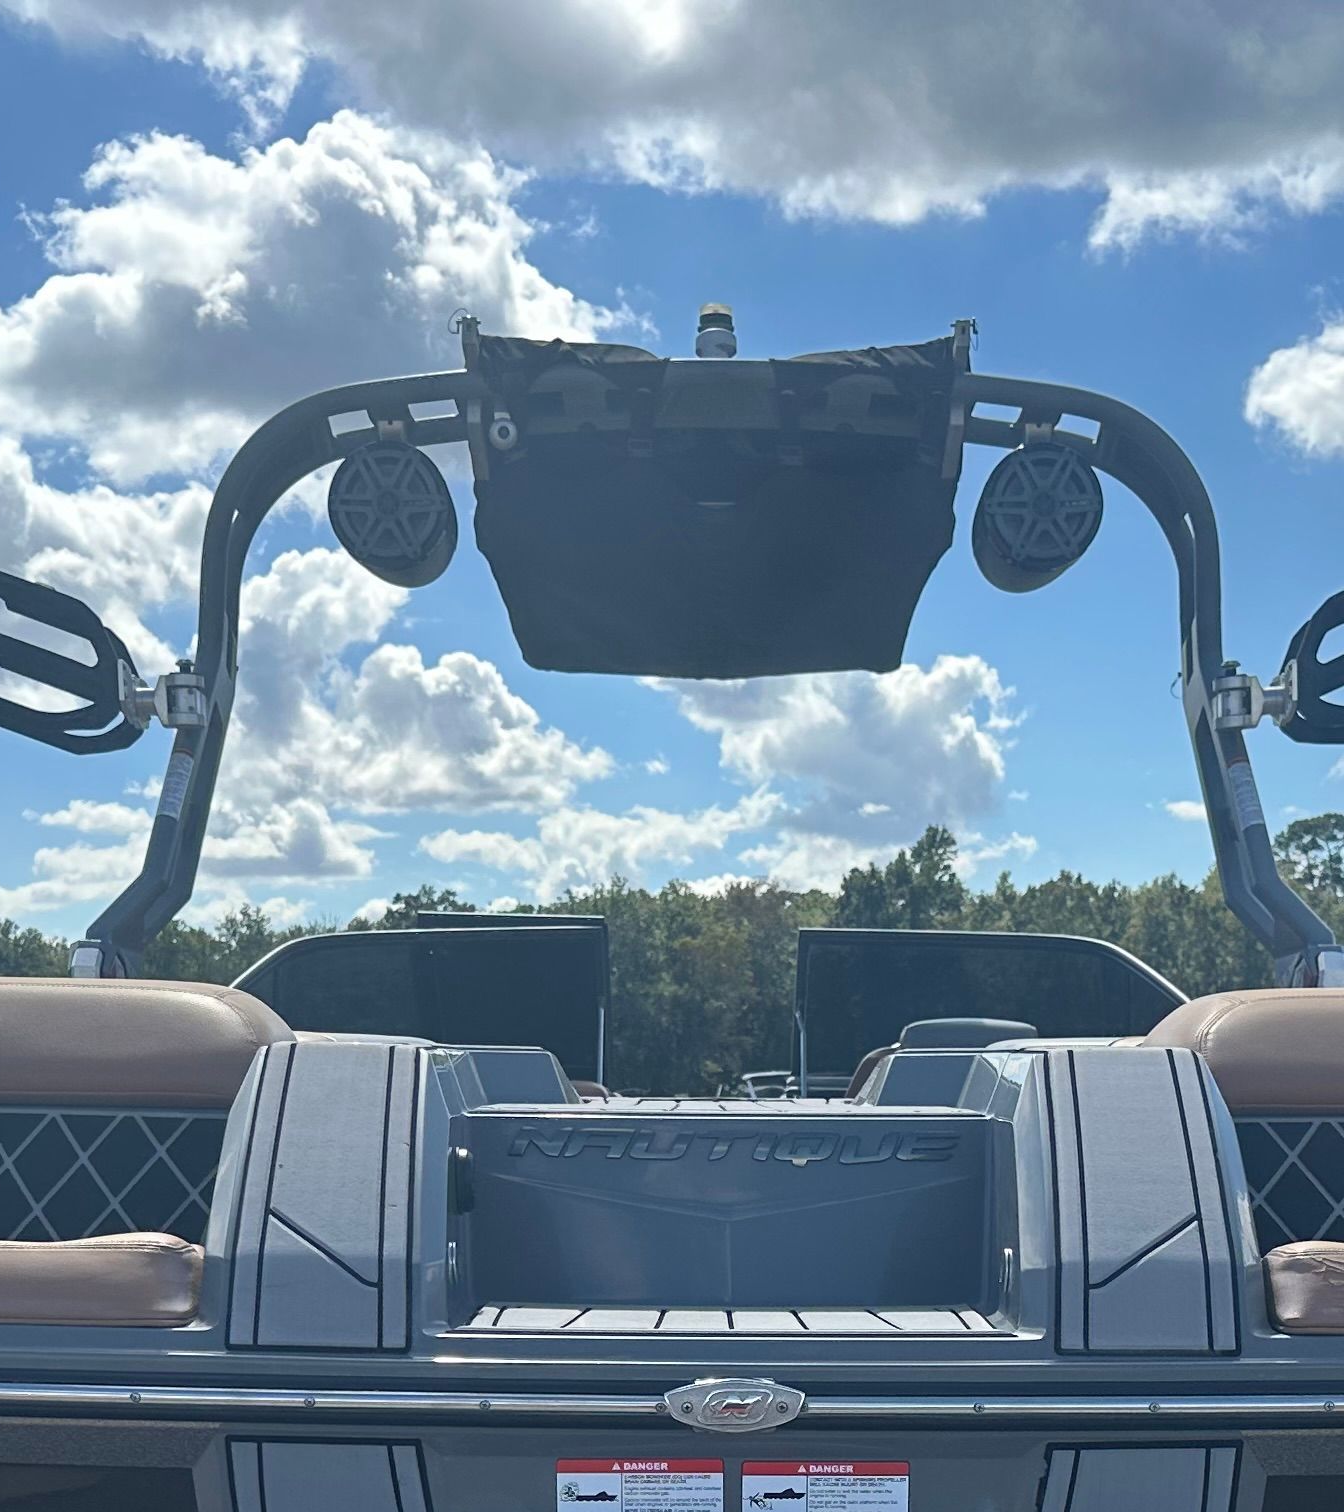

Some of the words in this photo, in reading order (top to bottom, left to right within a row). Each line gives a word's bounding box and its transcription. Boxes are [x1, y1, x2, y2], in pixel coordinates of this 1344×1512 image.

[507, 1125, 962, 1166] NAUTIQUE
[623, 1462, 669, 1471] DANGER
[809, 1464, 854, 1473] DANGER
